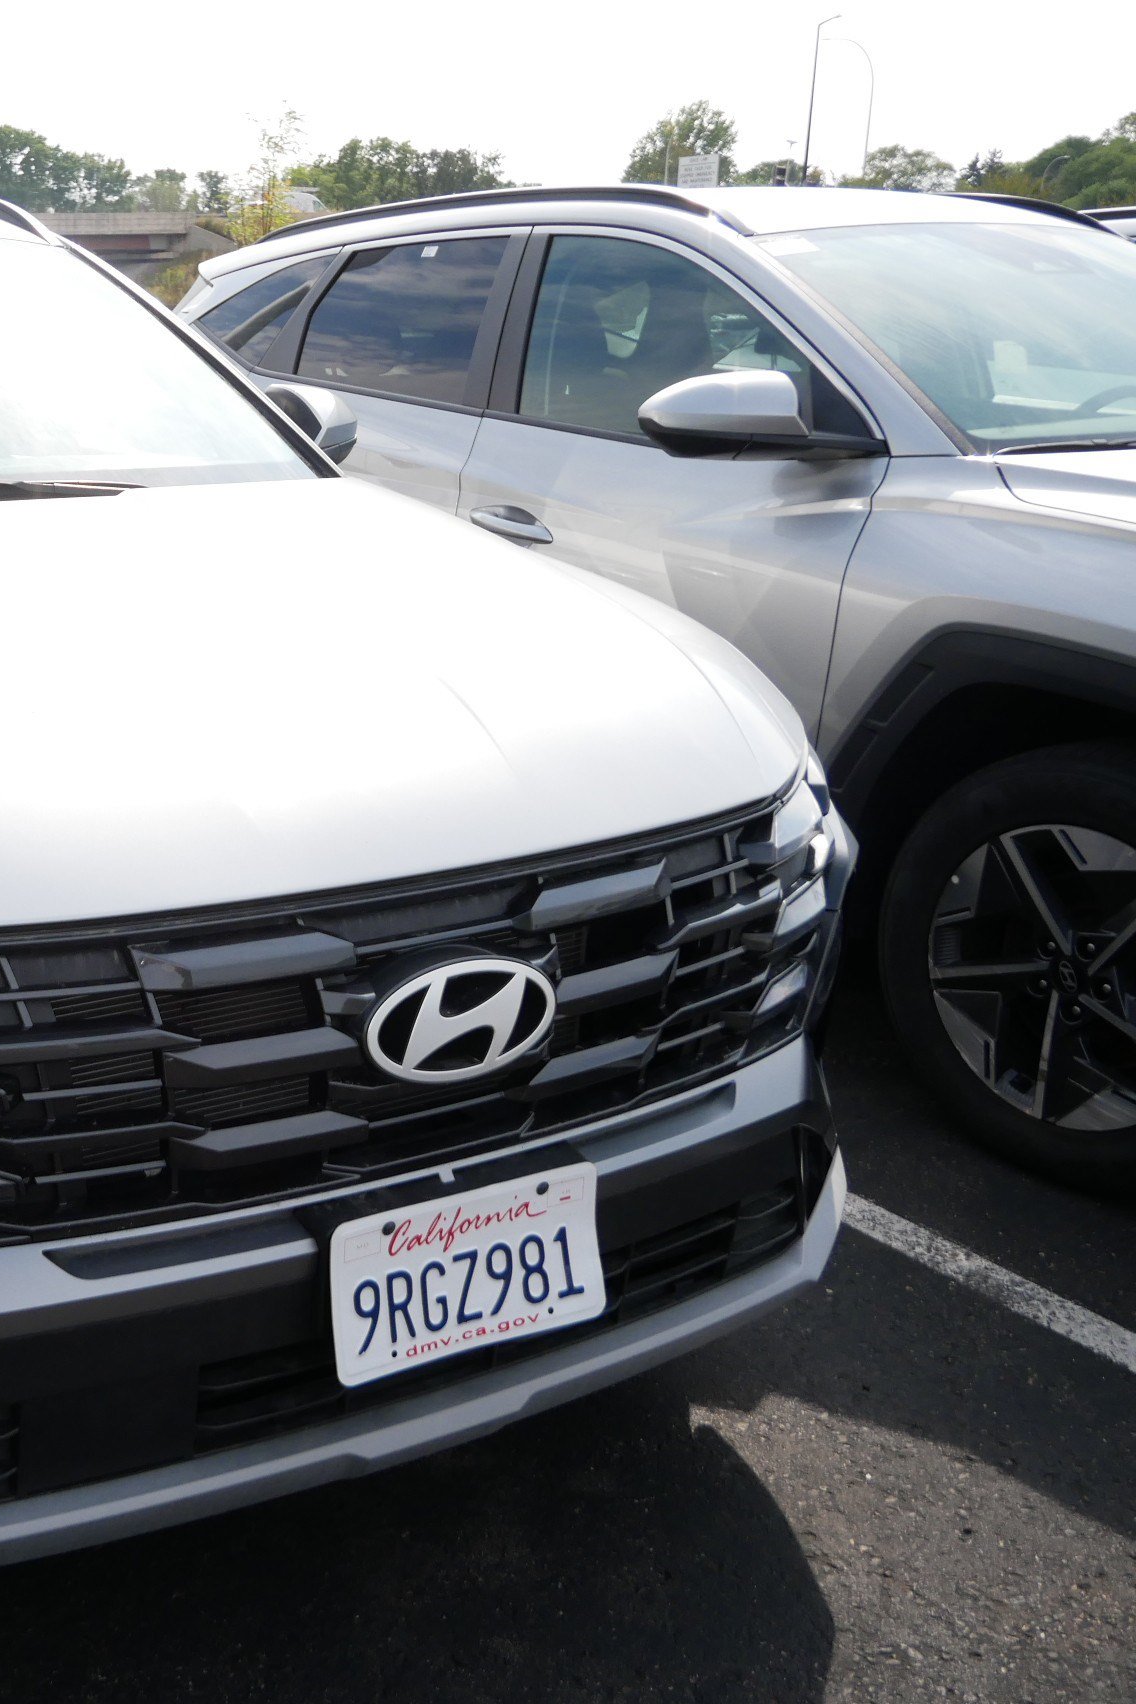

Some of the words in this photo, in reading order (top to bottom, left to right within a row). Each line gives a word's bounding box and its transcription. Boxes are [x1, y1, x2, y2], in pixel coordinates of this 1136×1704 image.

[388, 1195, 547, 1257] California
[353, 1226, 584, 1355] 9RGZ981
[405, 1313, 540, 1358] dmv.ca.gov
